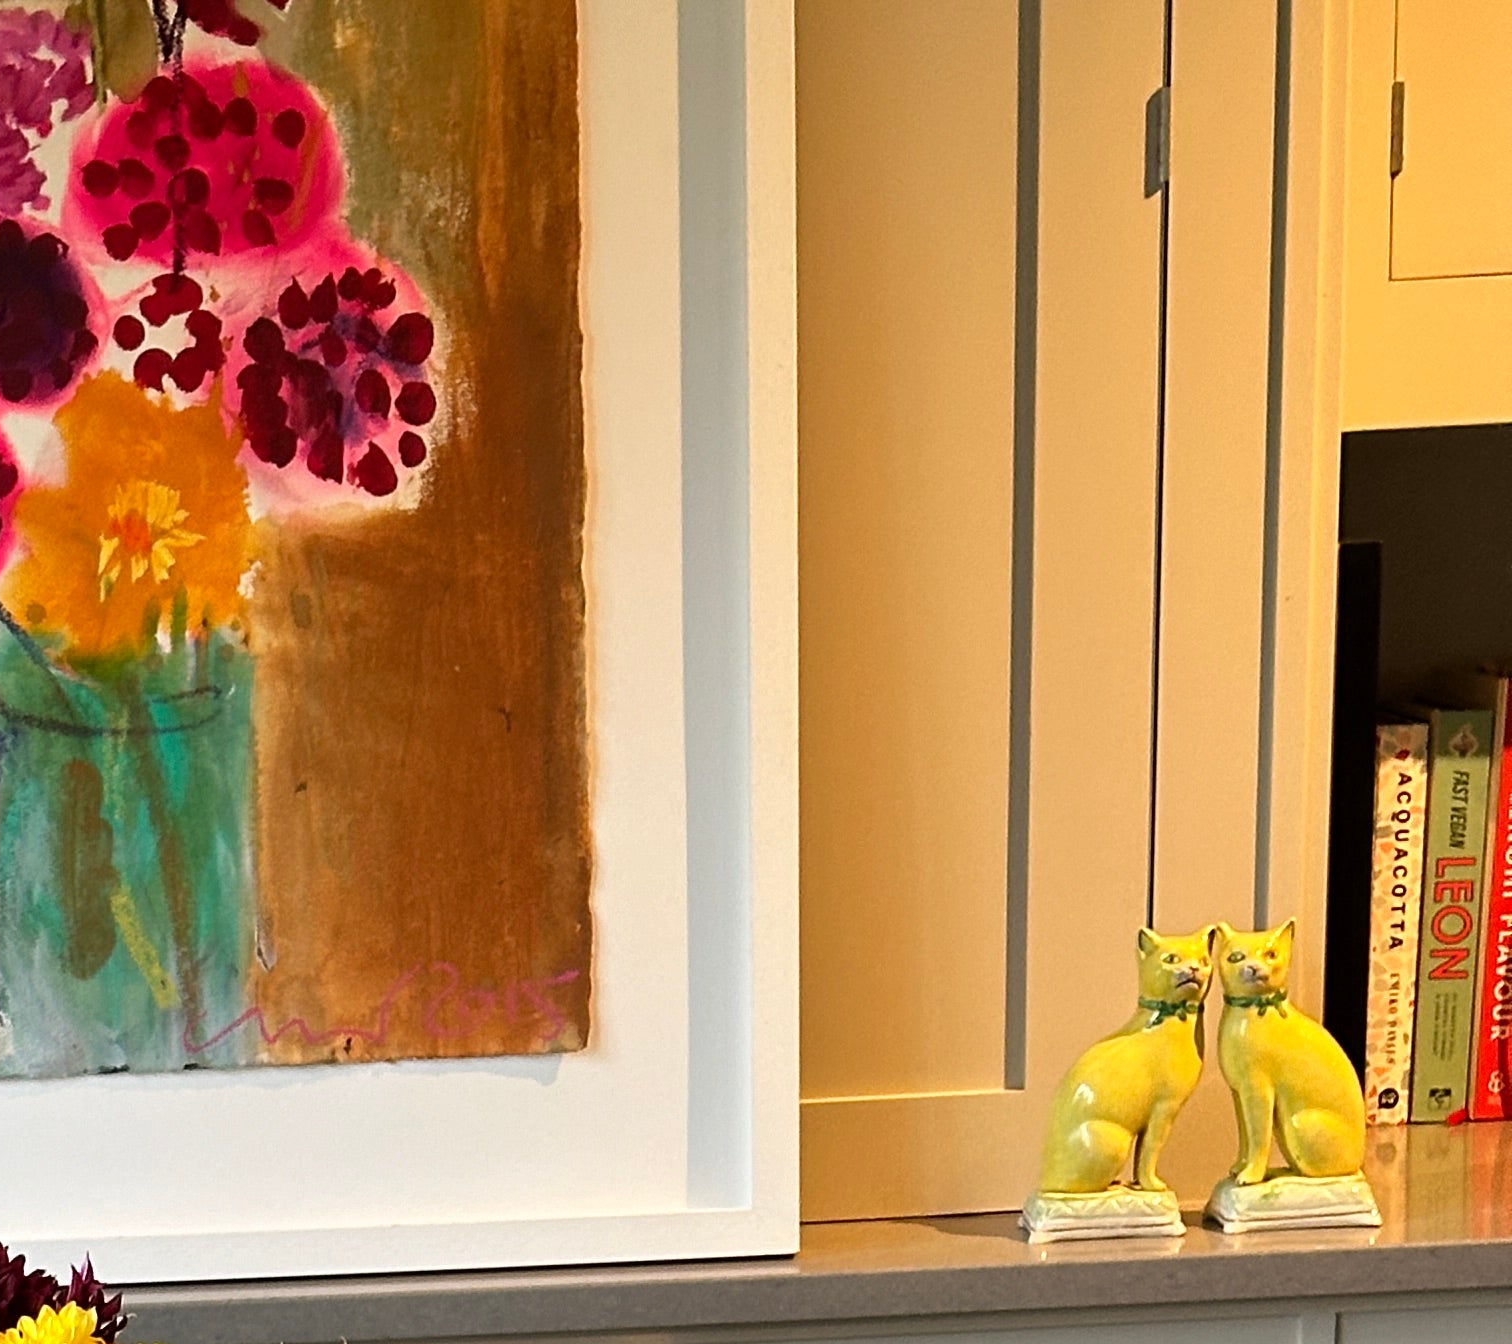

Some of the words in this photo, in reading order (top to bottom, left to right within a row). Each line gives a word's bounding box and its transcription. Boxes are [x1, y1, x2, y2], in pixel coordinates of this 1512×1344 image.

[1448, 806, 1468, 849] VEGAN
[1451, 769, 1470, 804] FAST
[1389, 772, 1413, 950] ACQUACOTTA
[1428, 856, 1477, 981] LEON
[1490, 913, 1512, 1040] FLAVOUR
